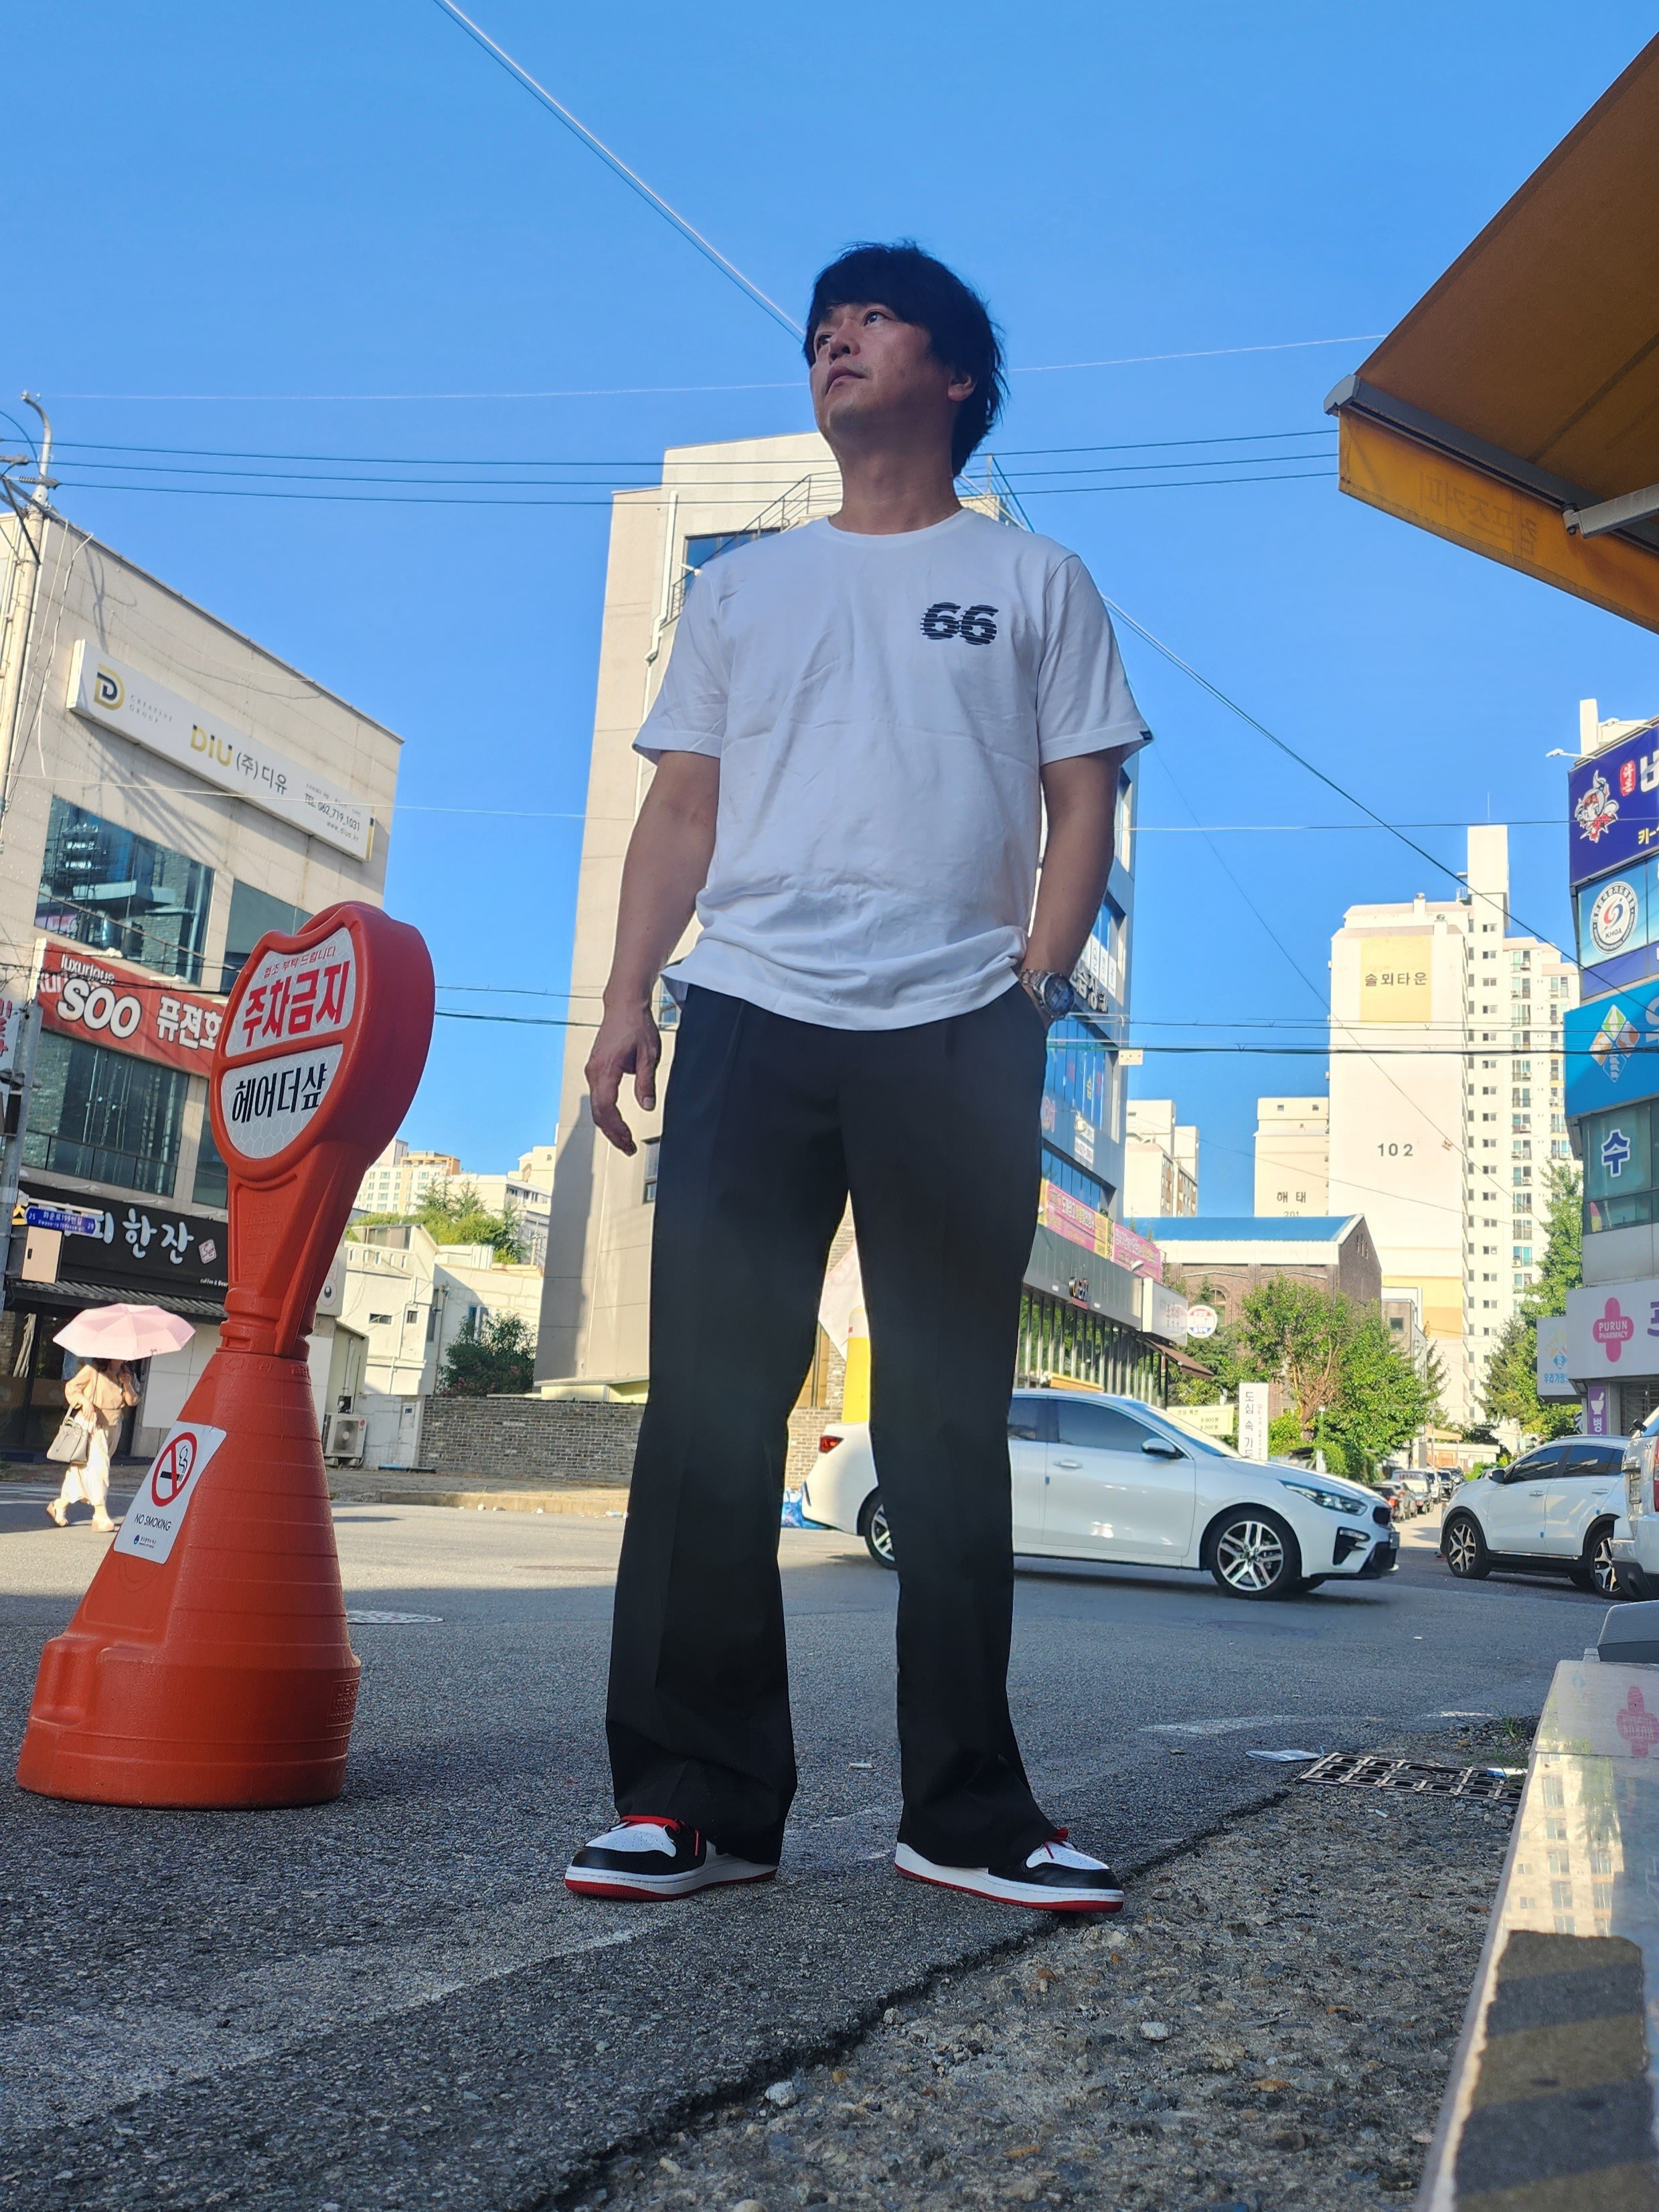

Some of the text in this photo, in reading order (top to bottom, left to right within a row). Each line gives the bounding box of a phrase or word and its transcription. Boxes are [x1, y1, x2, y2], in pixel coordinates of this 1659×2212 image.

[920, 602, 999, 645] 66
[264, 946, 336, 979] 협조 부탁 드립니다
[1364, 972, 1427, 987] 솔뫼타운
[58, 977, 142, 1038] SOO
[242, 961, 350, 1048] 주차금지
[1378, 1143, 1413, 1157] 102
[28, 1212, 36, 1220] 25
[1599, 1320, 1627, 1332] PURUN
[1599, 1331, 1628, 1340] PHARMACY
[1544, 1373, 1568, 1384] 우리가정
[134, 1513, 171, 1531] NO SMOKING
